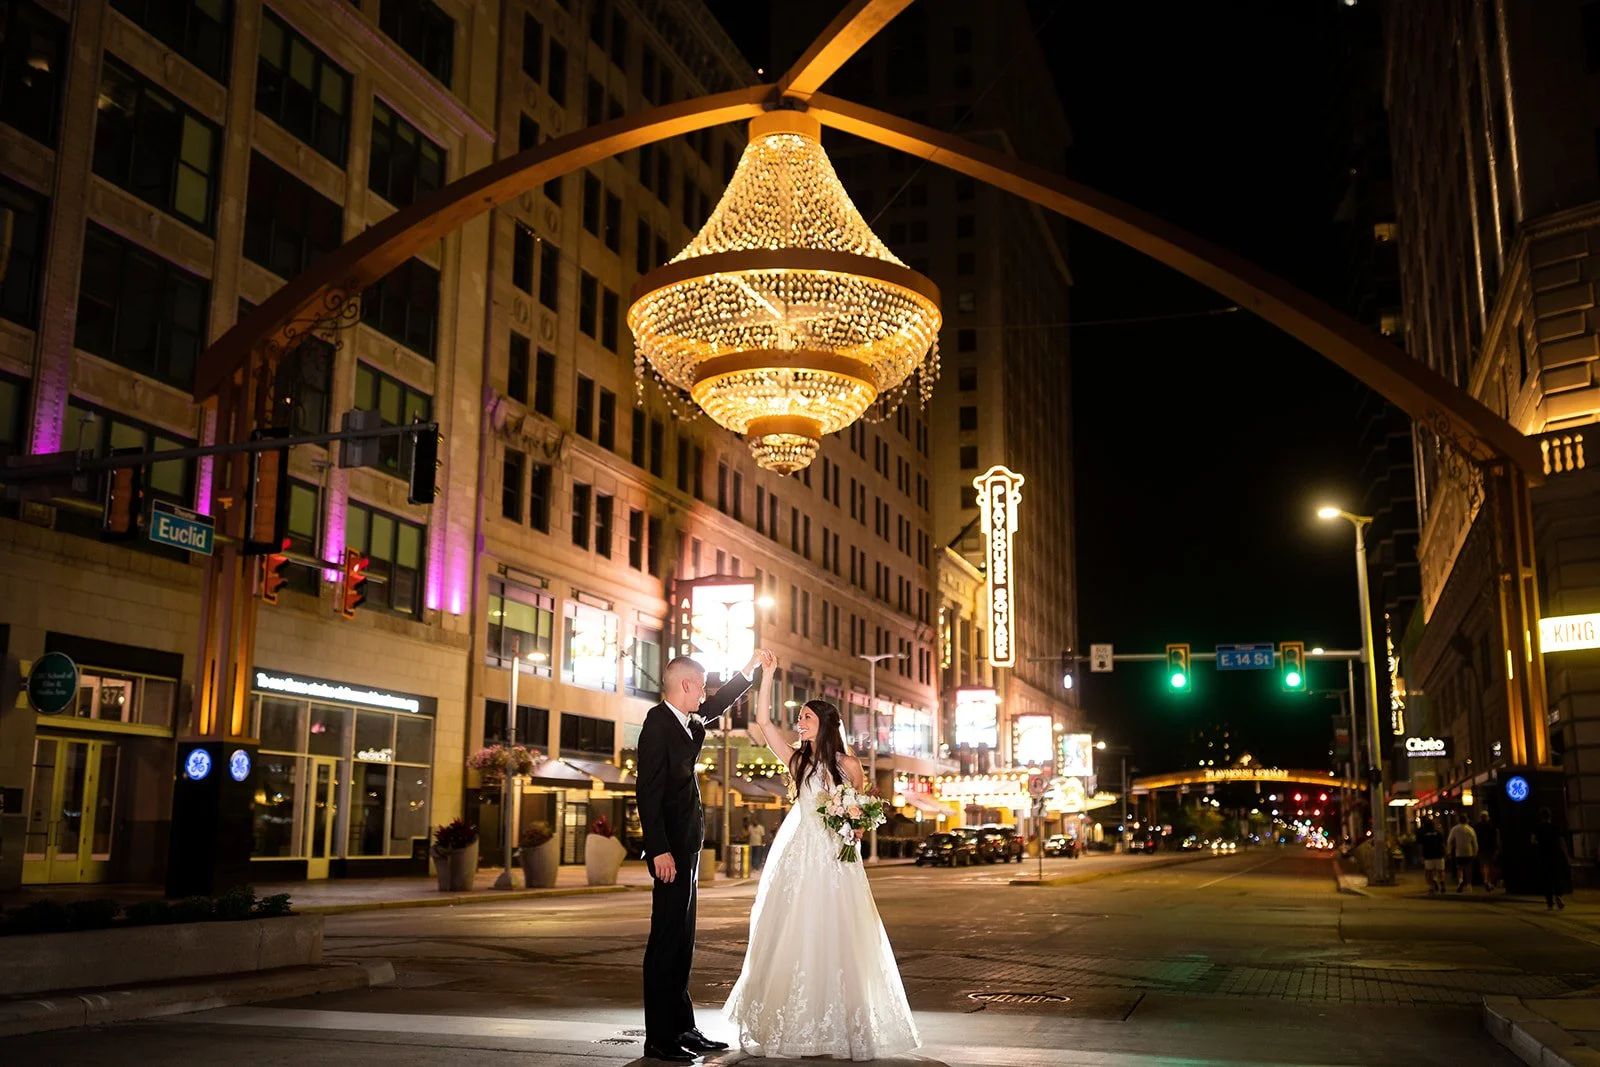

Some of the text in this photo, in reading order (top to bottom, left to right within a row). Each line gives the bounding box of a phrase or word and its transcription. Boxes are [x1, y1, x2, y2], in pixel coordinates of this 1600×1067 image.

[159, 517, 207, 548] Euclid
[993, 588, 1008, 659] SQUARE
[1235, 654, 1250, 665] 14
[1253, 652, 1270, 665] St
